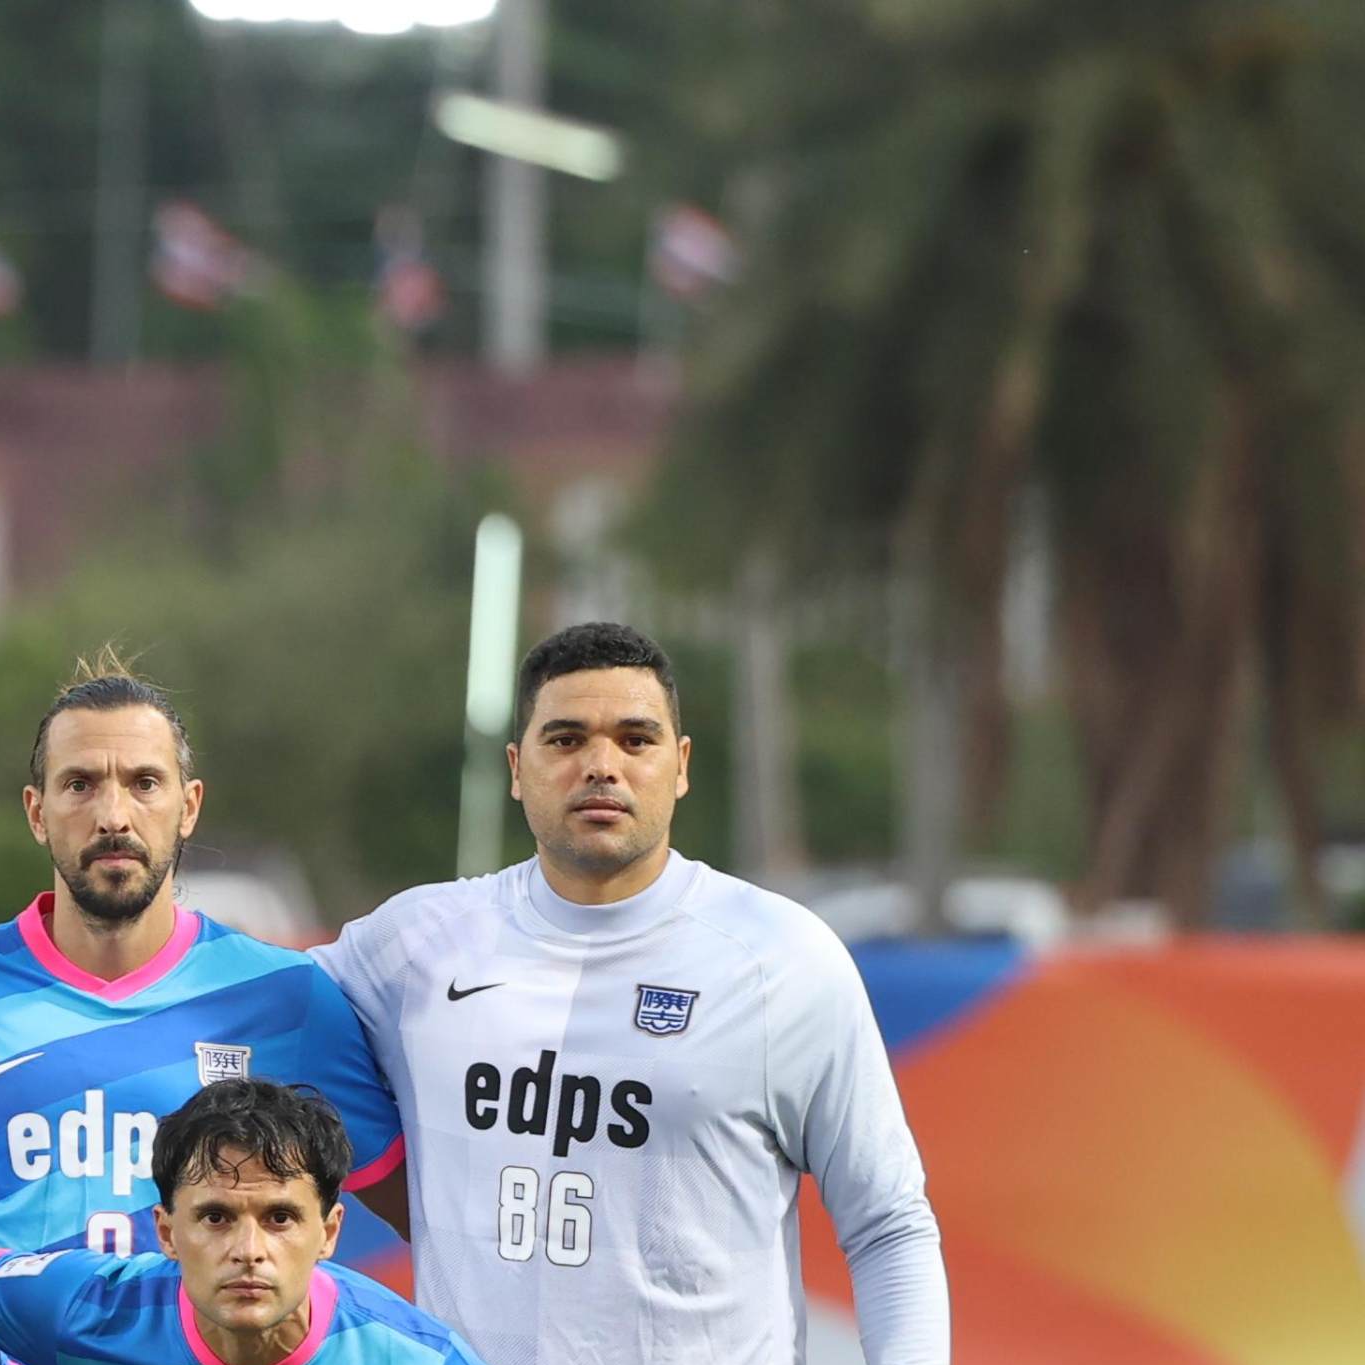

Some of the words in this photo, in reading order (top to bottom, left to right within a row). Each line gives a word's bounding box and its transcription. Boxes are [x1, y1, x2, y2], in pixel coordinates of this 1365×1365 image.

[7, 1089, 158, 1196] edp
[465, 1049, 653, 1158] edps
[497, 1165, 595, 1268] 86
